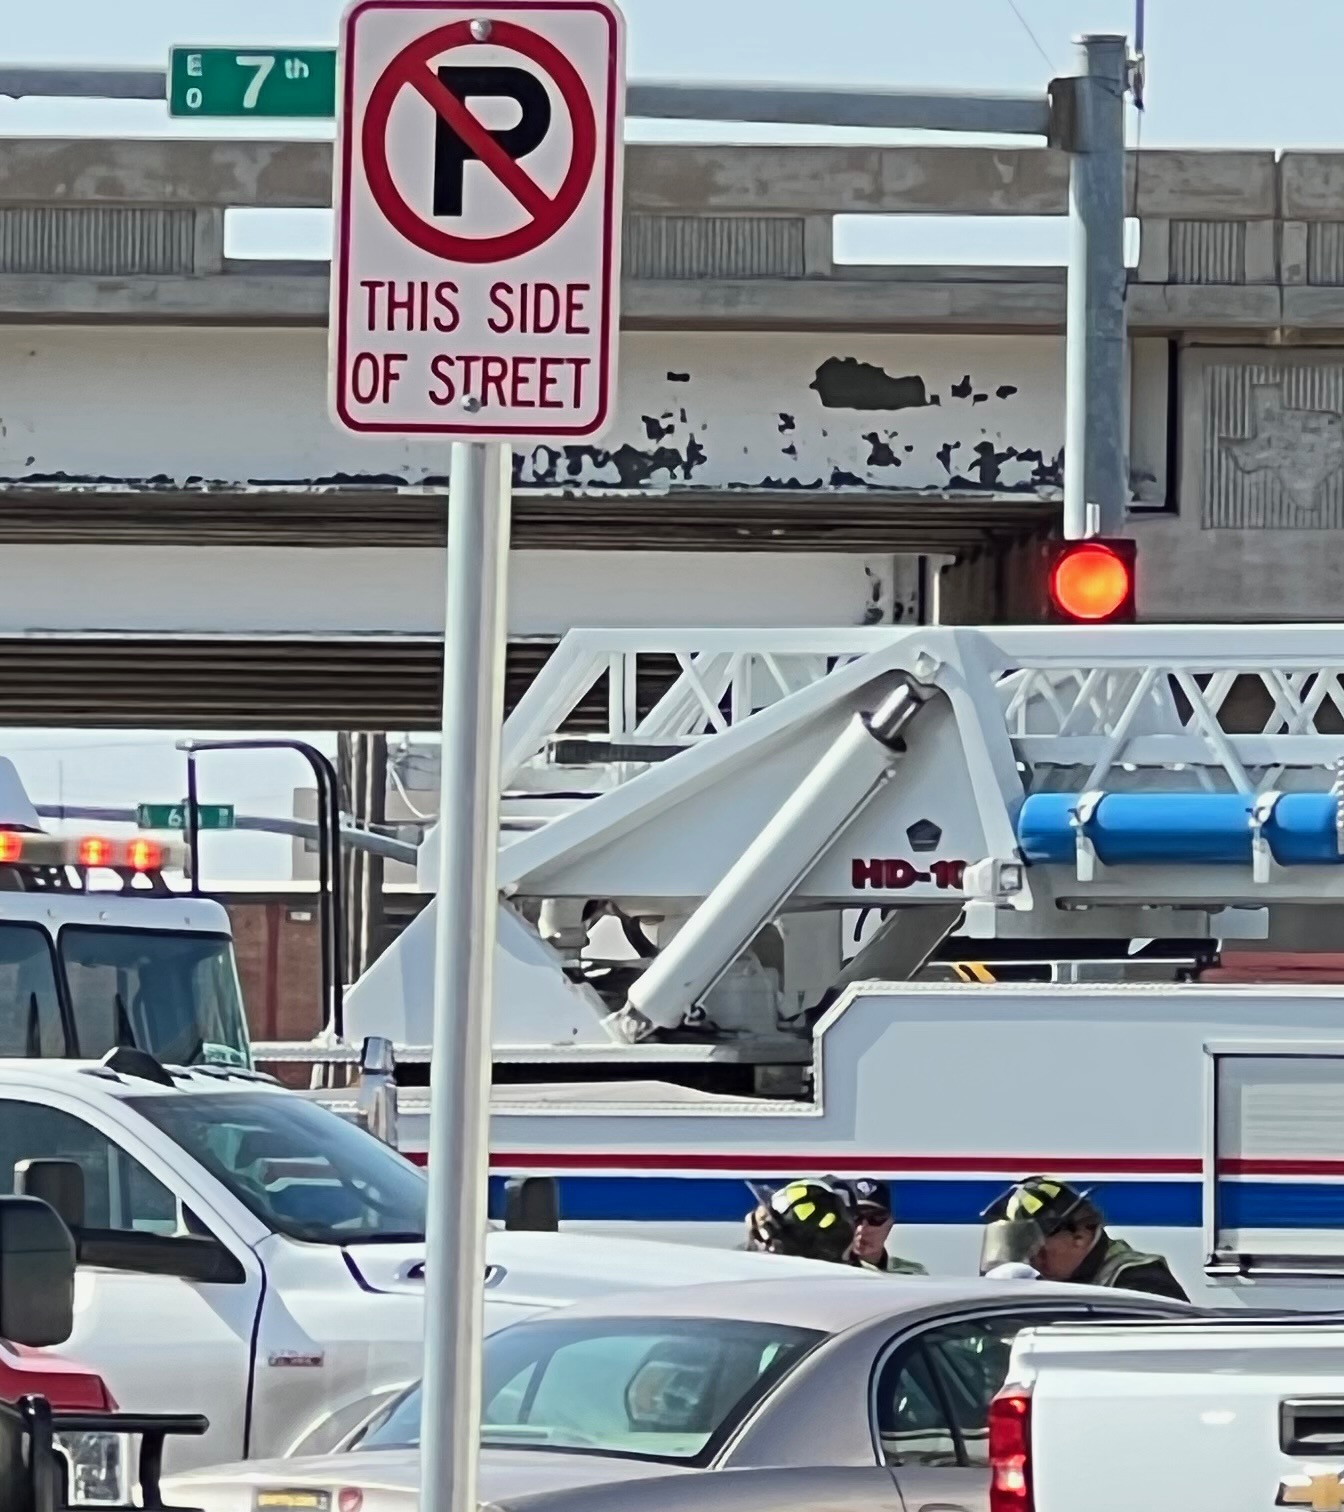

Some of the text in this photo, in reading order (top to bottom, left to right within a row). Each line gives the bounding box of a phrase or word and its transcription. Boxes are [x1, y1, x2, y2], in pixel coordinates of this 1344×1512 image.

[359, 280, 591, 335] THIS SIDE
[351, 352, 591, 409] OF STREET
